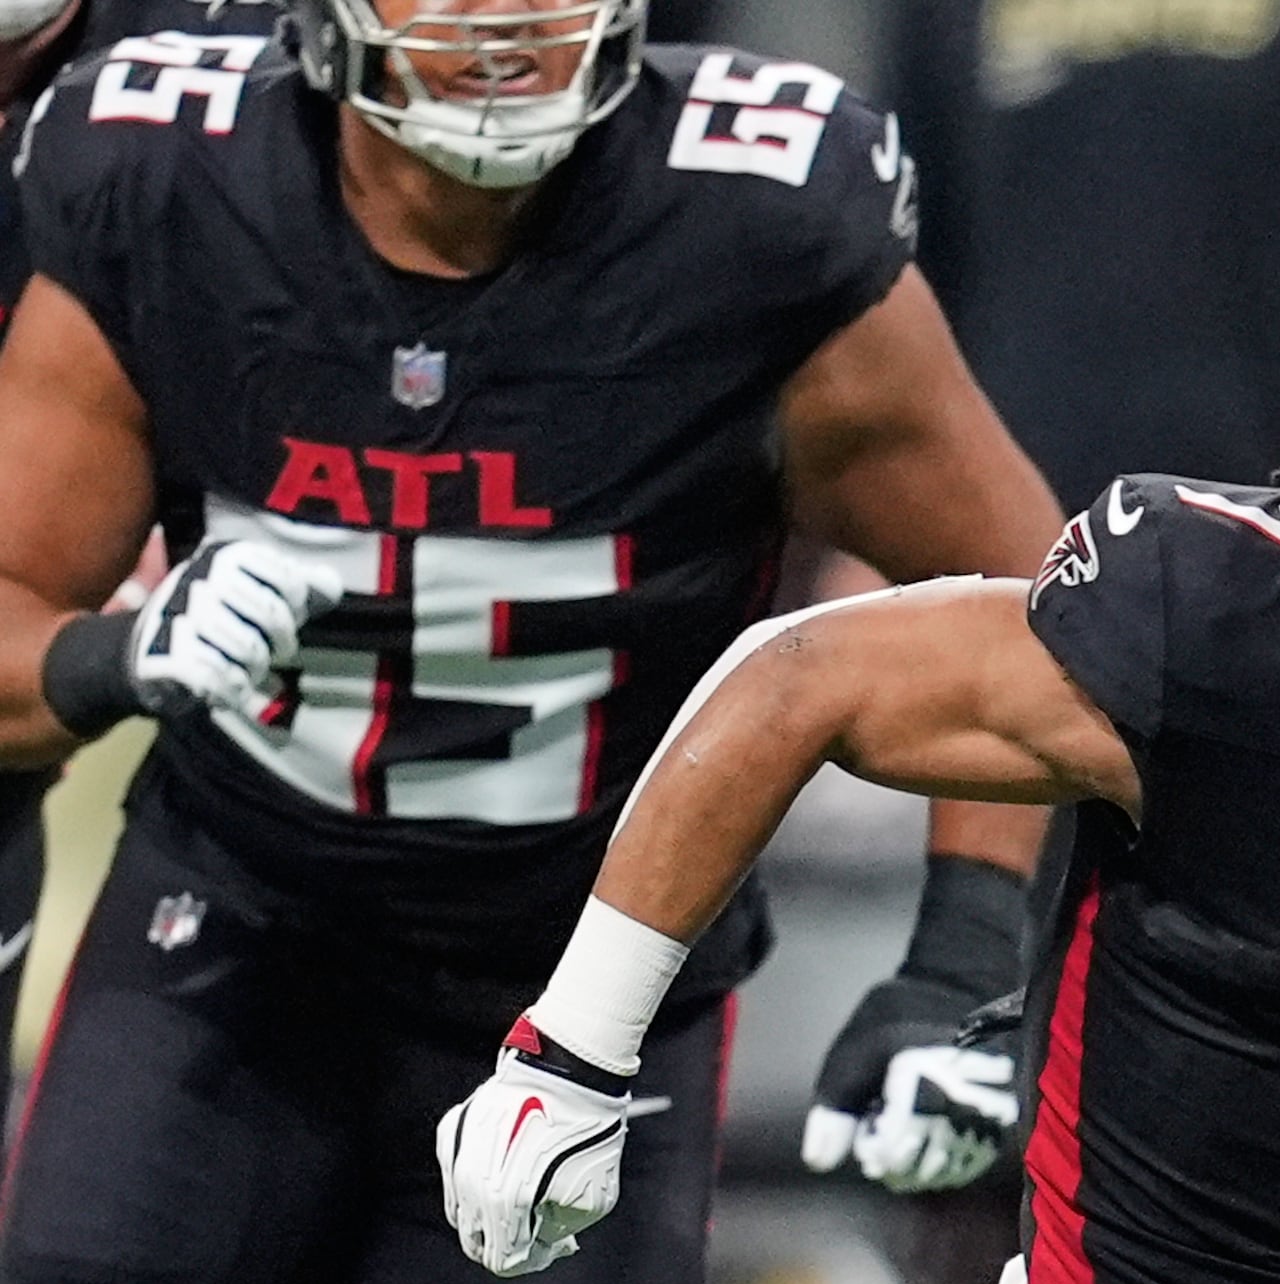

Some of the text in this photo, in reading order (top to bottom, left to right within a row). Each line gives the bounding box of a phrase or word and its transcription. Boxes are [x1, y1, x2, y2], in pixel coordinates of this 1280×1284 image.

[87, 30, 267, 136] 65
[667, 53, 845, 187] 65
[264, 437, 554, 528] ATL
